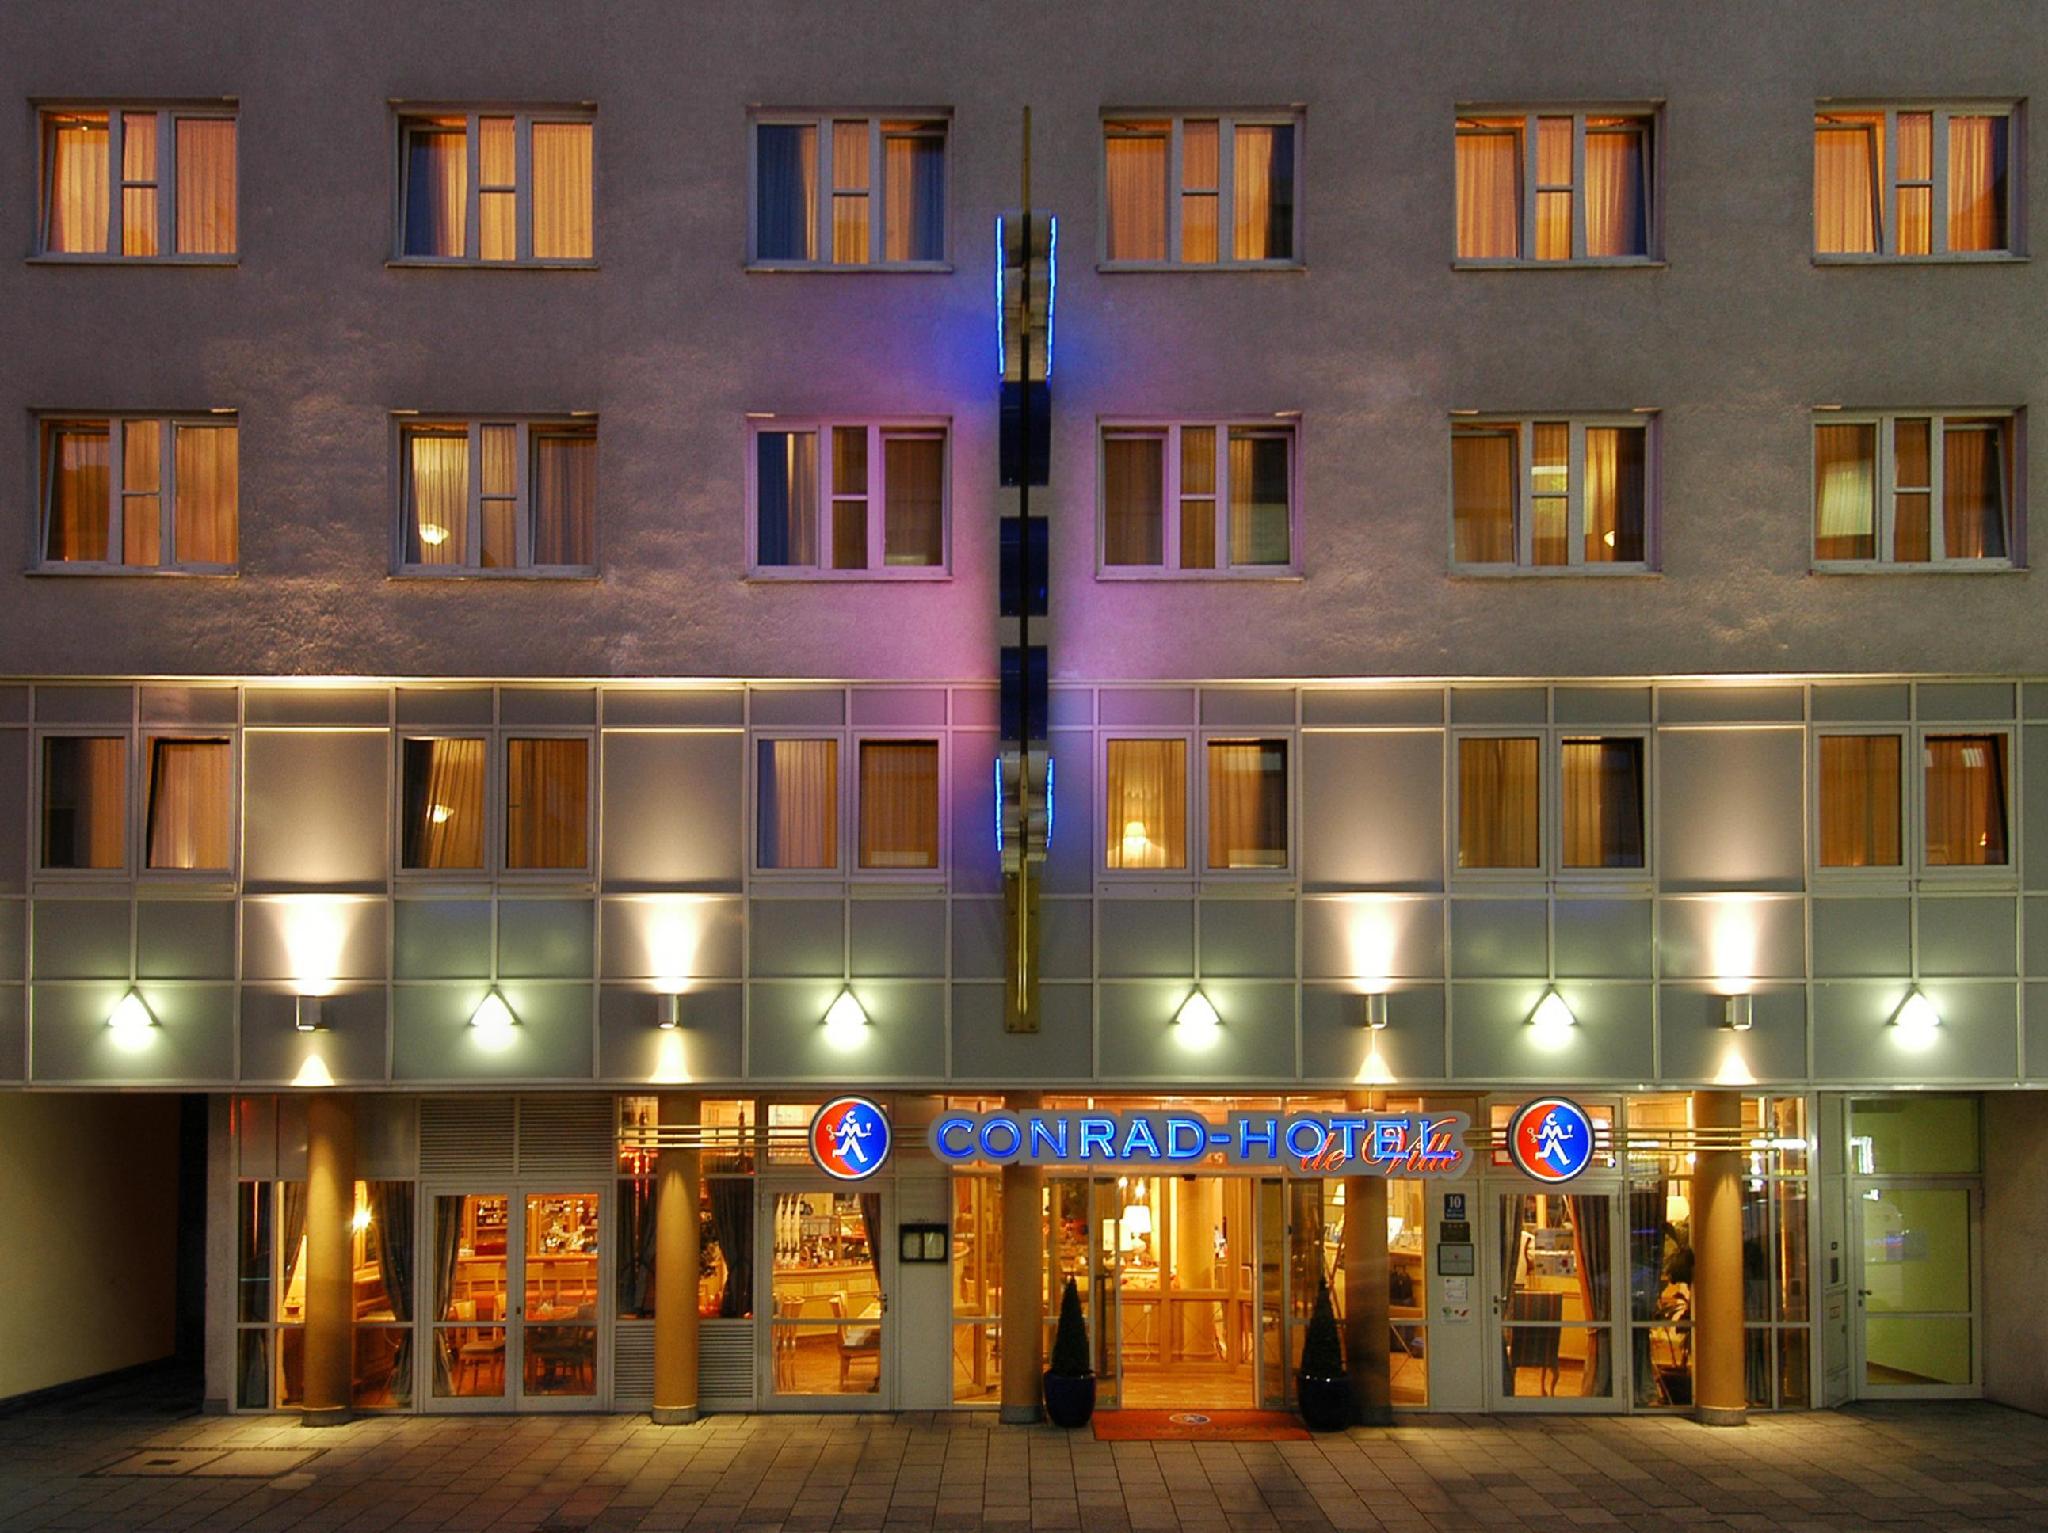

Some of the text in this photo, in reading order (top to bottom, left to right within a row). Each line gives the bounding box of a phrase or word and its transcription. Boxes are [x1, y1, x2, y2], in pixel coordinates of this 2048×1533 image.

[936, 1118, 1457, 1160] CONRAD-HOTEL
[1299, 1116, 1463, 1176] de Ville
[1448, 1195, 1461, 1209] 10
